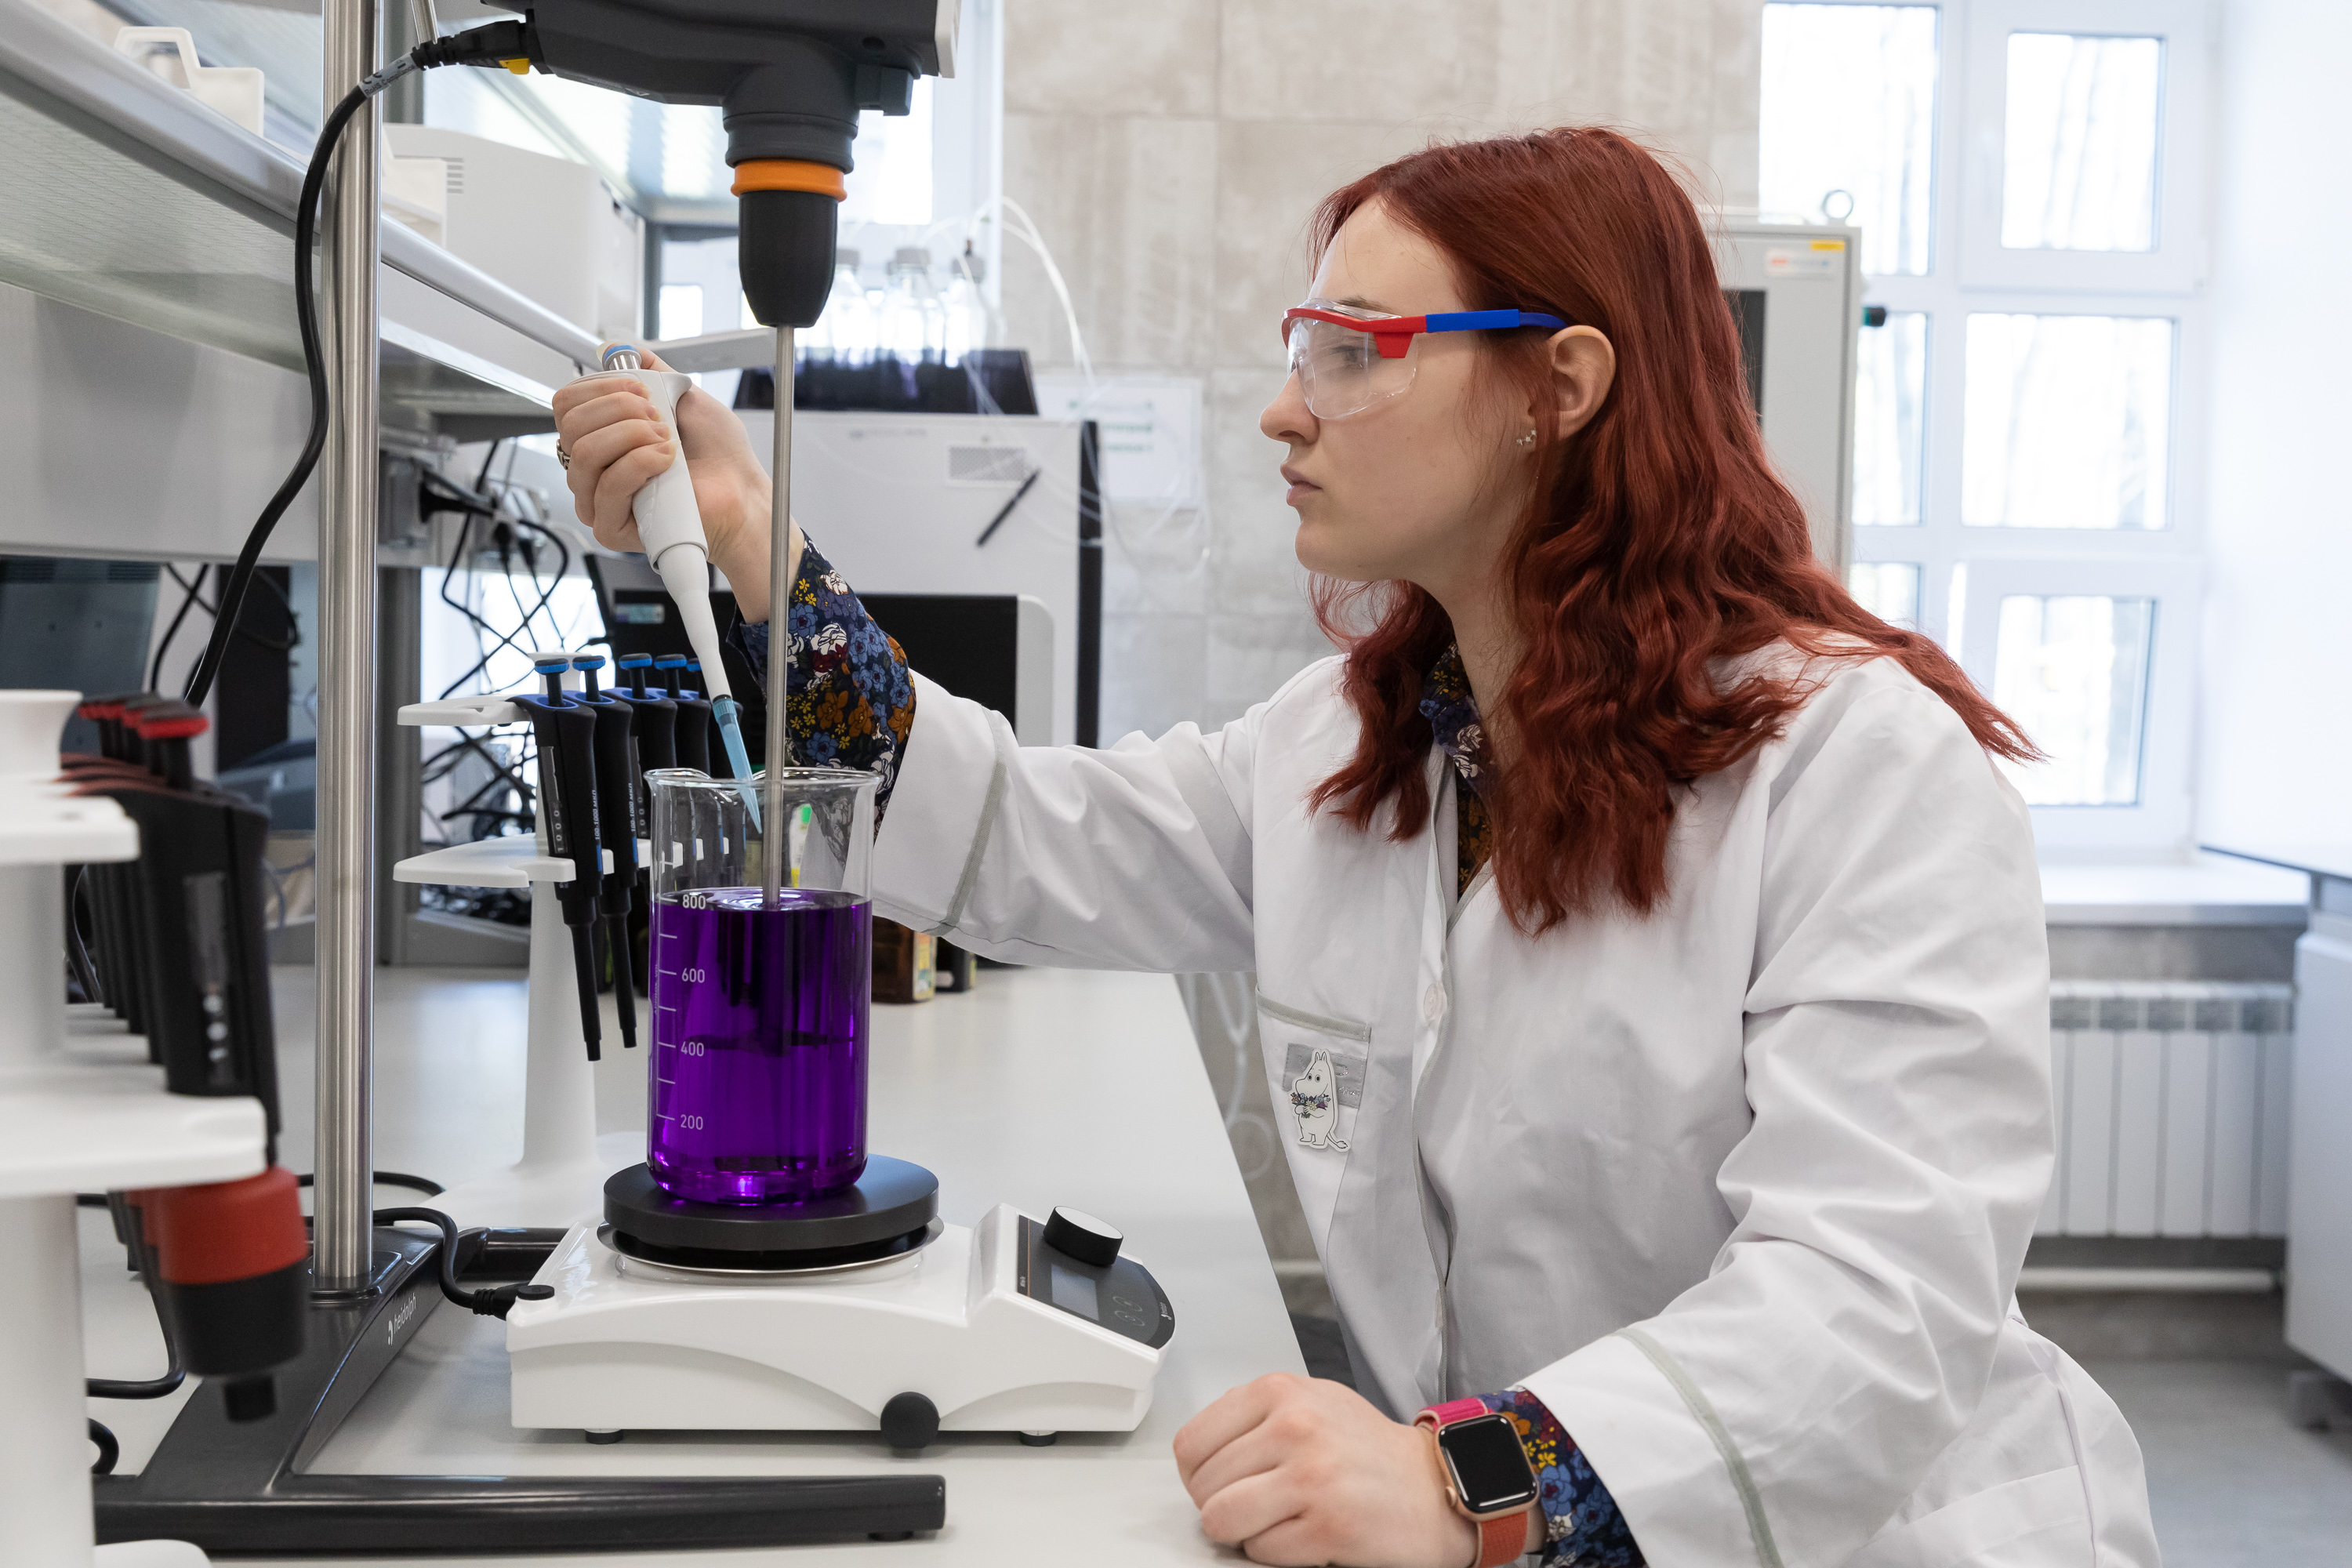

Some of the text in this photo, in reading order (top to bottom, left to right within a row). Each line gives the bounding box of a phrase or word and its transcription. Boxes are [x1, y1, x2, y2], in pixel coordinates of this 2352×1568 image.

[364, 82, 383, 95] RoHS
[592, 808, 601, 840] 100-1000
[682, 894, 706, 910] 800
[681, 967, 706, 984] 600
[681, 1041, 705, 1057] 400
[681, 1114, 703, 1131] 200
[394, 1292, 416, 1334] heidolph
